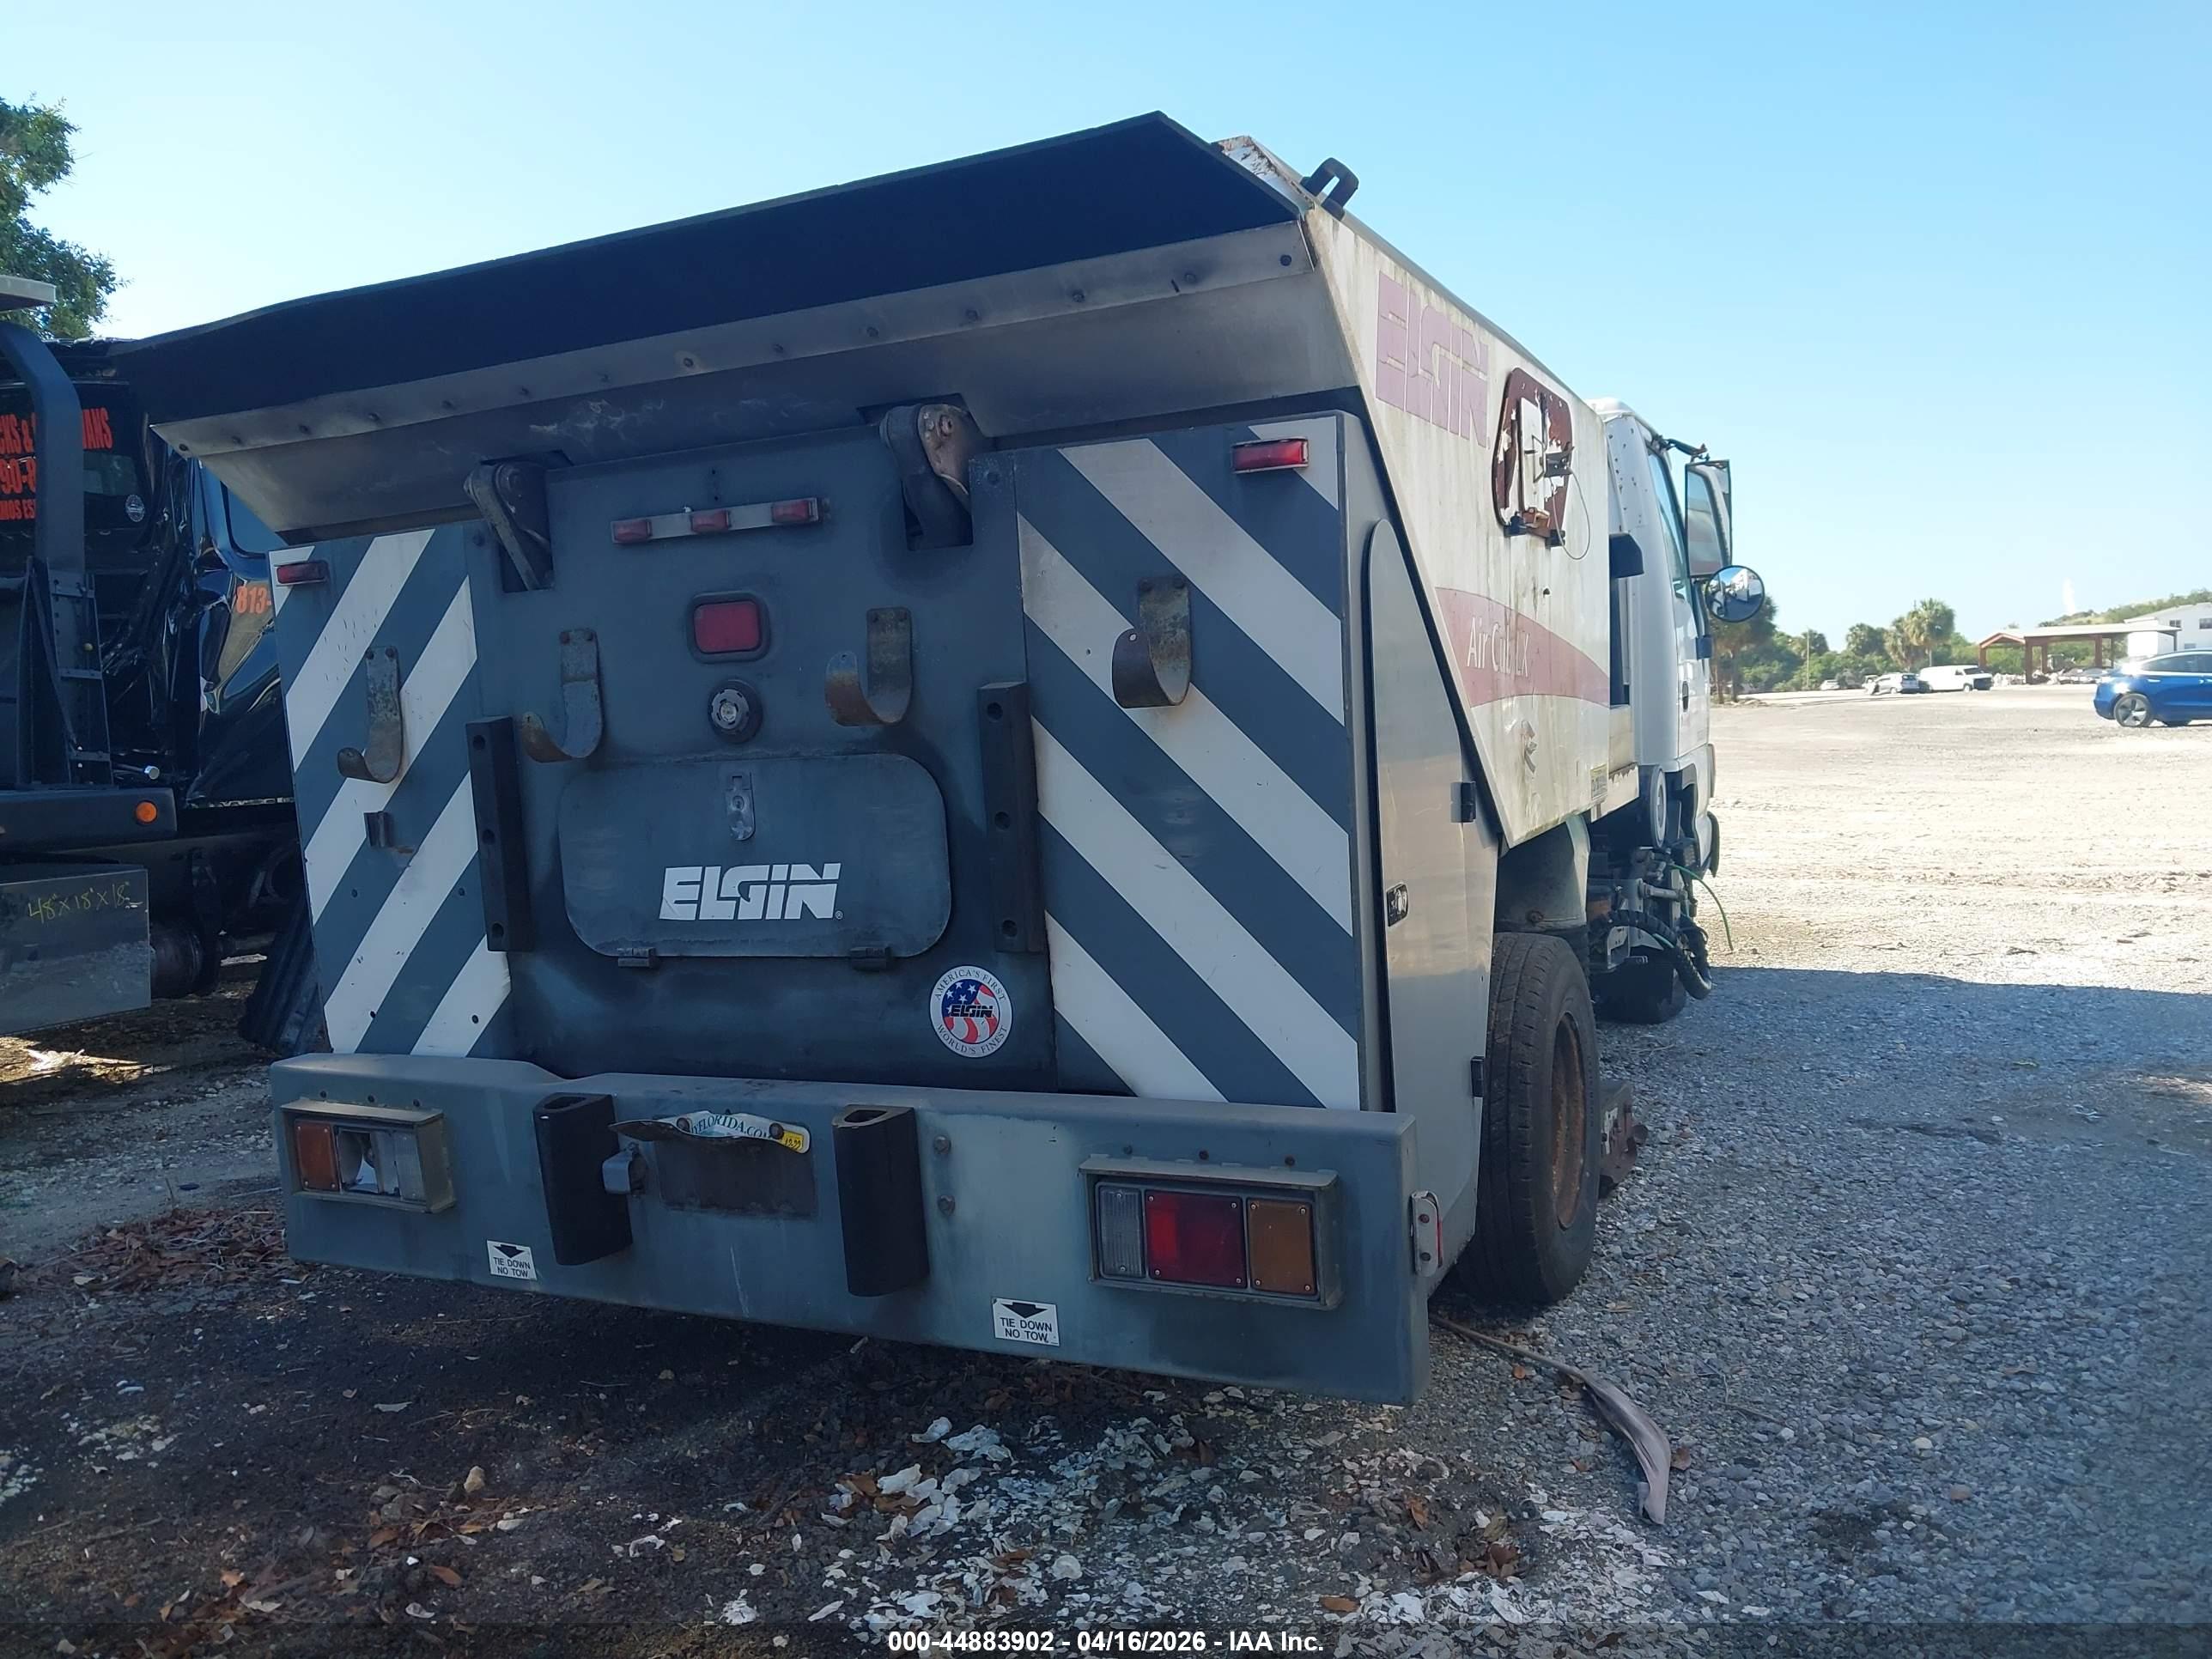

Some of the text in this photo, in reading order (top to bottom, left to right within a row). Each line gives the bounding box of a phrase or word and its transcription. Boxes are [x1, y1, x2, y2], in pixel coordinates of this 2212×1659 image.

[1467, 617, 1488, 669] Air
[934, 969, 1006, 1003] AMERICA'S FIRST
[950, 1004, 995, 1018] ELGIN
[937, 1024, 1007, 1054] WORLD'S FINEST
[493, 1256, 531, 1270] TIE DOWN
[497, 1266, 528, 1278] NO TOW
[1000, 1317, 1053, 1333] TIE DOWN
[1005, 1328, 1020, 1338] NO
